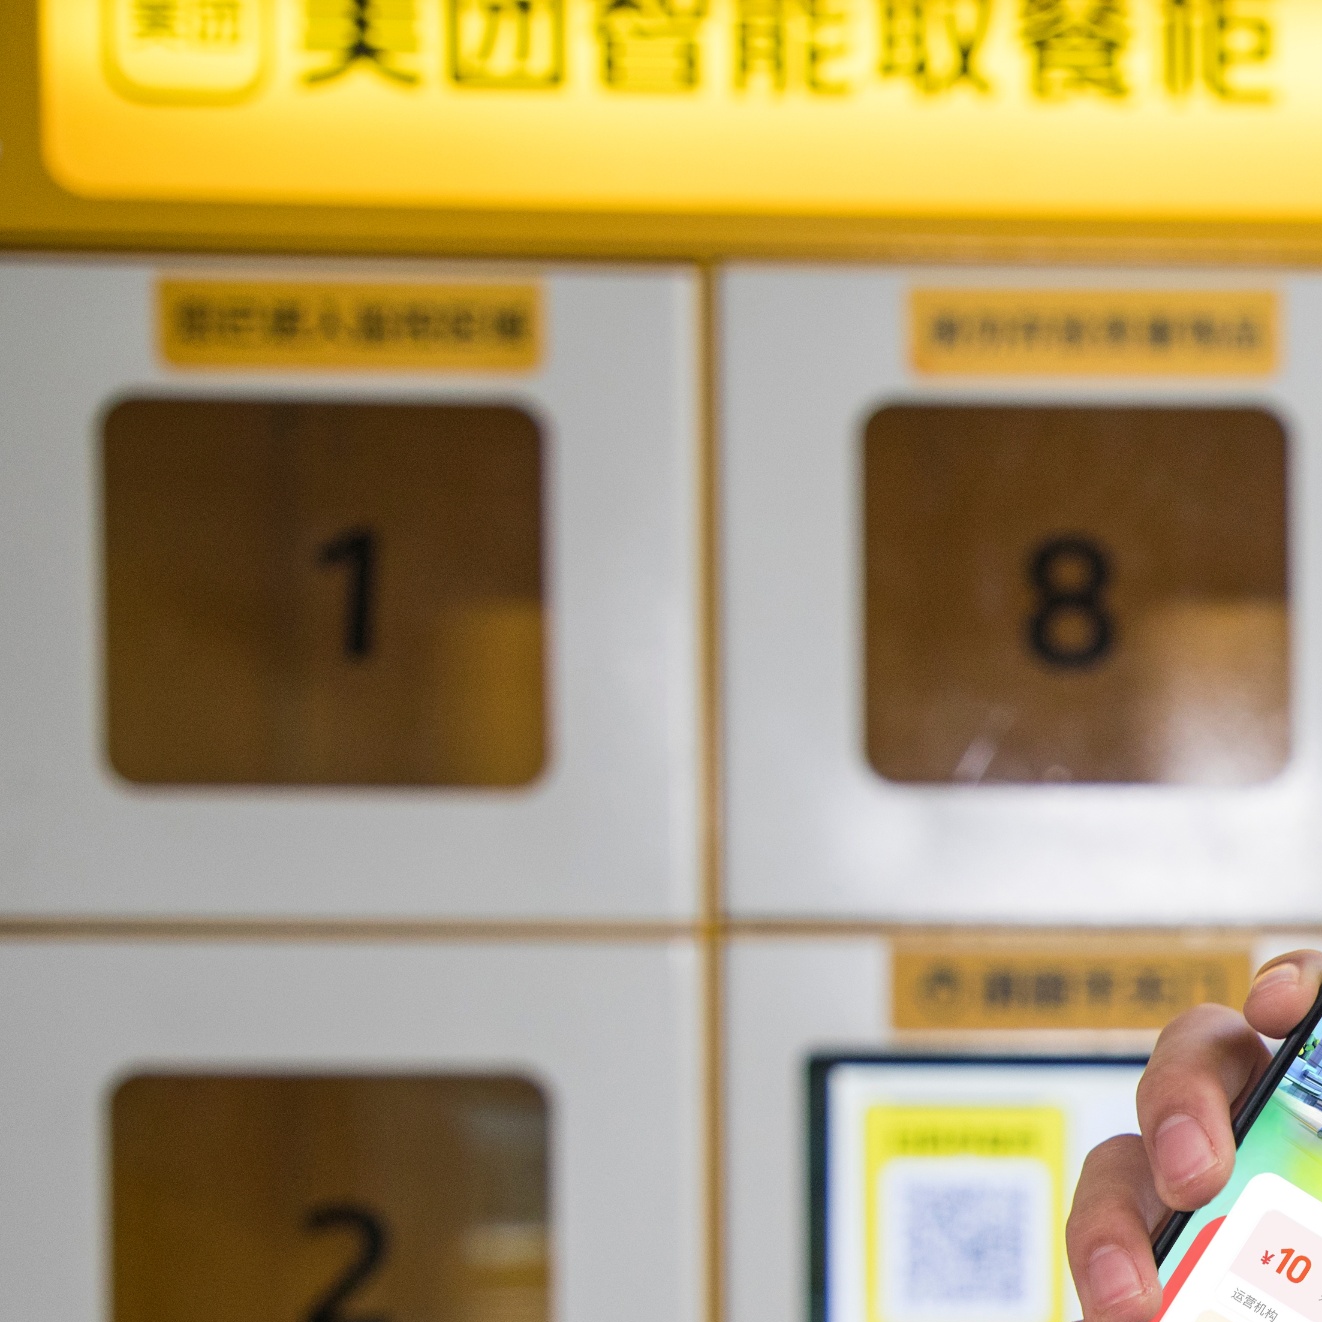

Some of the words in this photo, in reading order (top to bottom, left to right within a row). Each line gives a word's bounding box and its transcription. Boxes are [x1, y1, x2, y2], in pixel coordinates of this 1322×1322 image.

[302, 0, 1274, 102] 美团智能取餐柜
[316, 525, 383, 656] 1
[1024, 533, 1117, 670] 8
[1231, 1287, 1279, 1322] 运营机构
